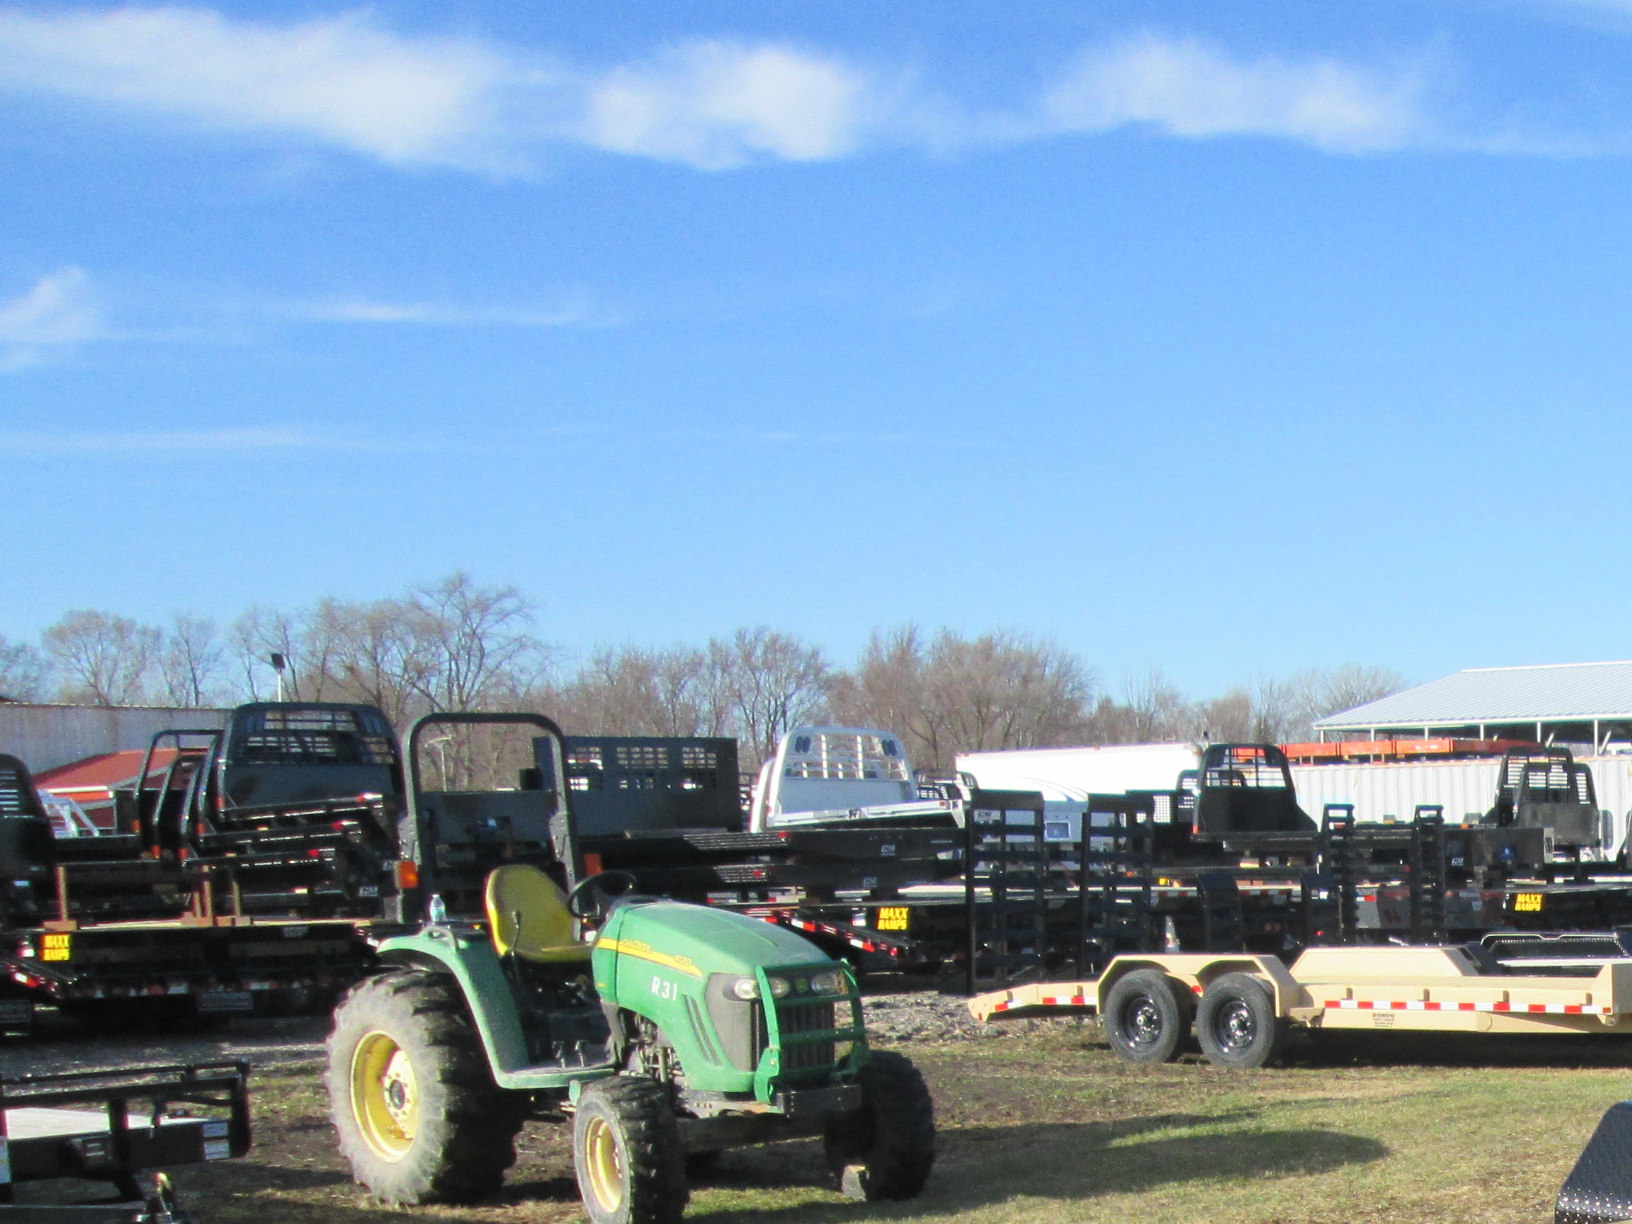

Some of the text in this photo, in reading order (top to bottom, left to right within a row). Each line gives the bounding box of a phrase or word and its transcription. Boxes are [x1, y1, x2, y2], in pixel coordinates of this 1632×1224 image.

[1516, 894, 1543, 904] MAXX
[1514, 903, 1542, 912] RAMPS
[880, 907, 909, 919] MAXX
[877, 919, 908, 930] RAMPS
